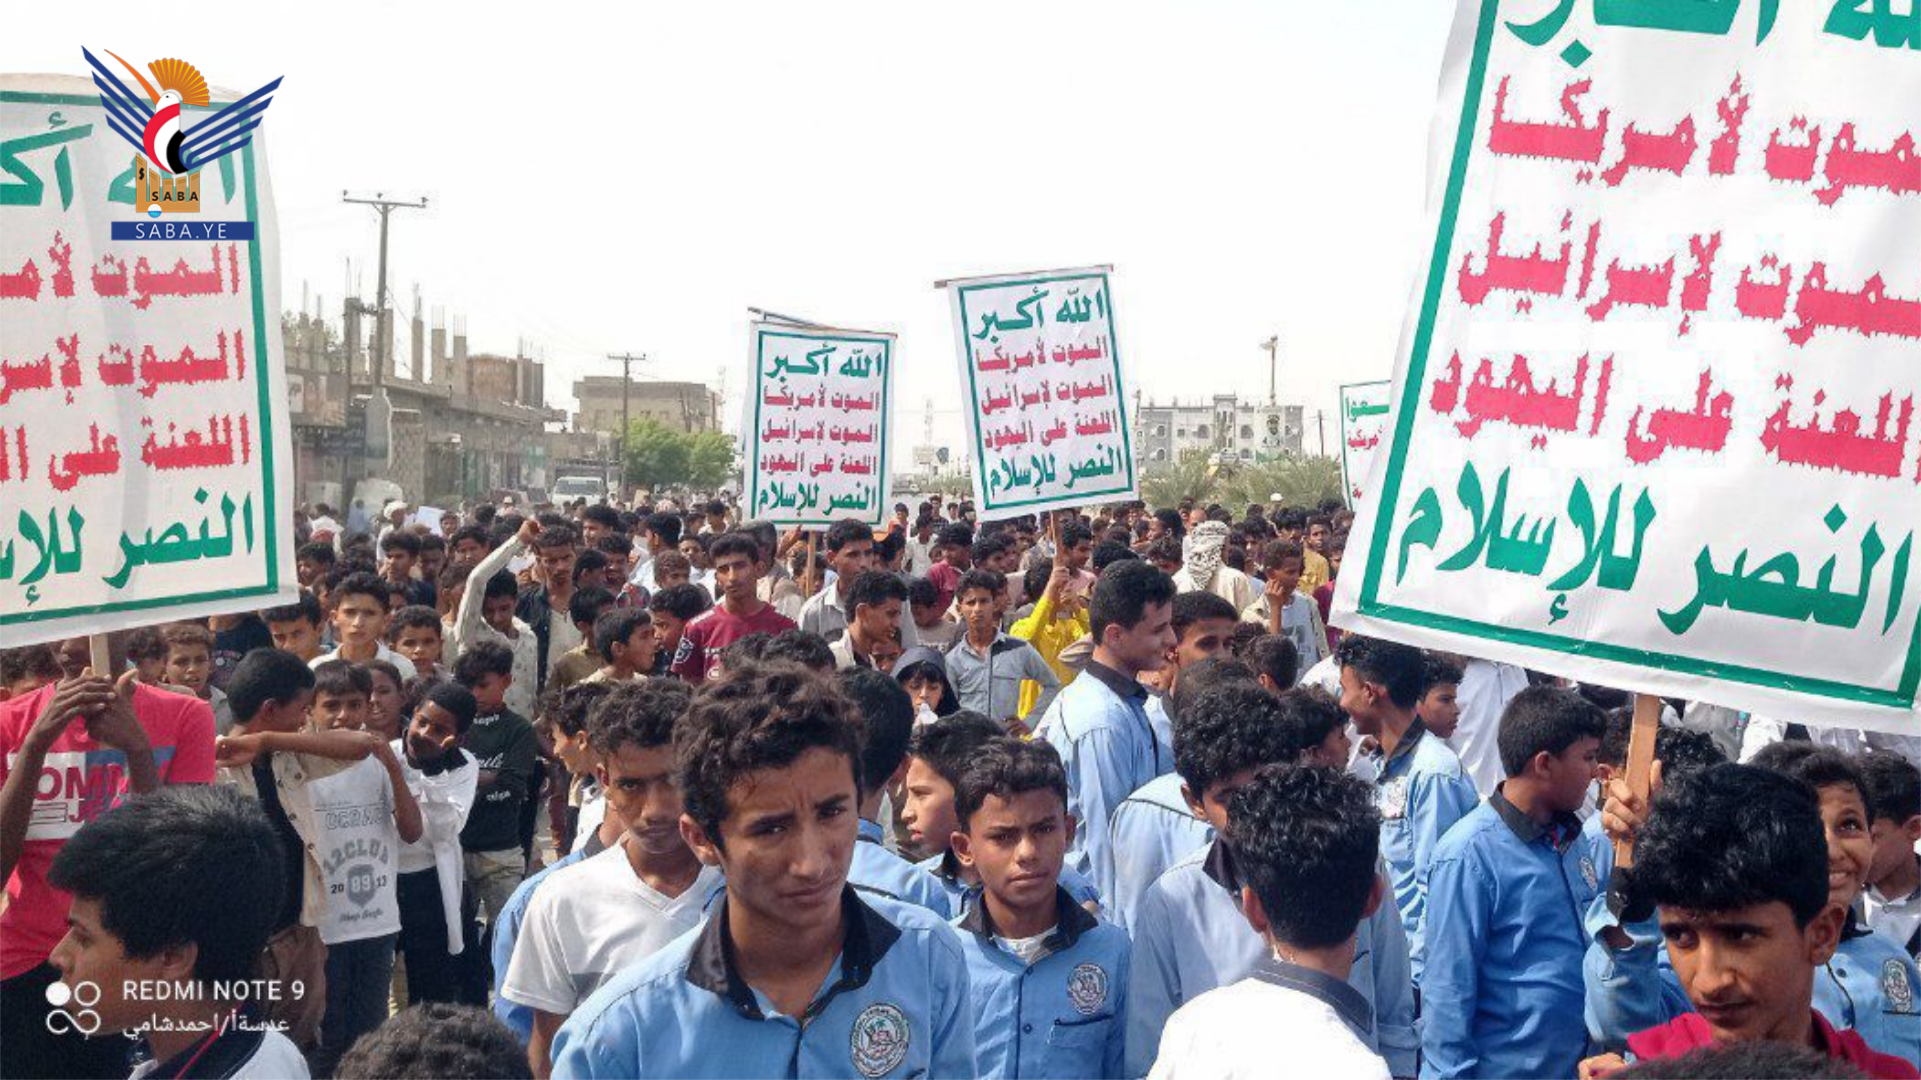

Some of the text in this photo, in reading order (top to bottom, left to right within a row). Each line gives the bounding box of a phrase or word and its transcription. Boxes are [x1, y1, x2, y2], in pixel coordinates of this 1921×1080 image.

[1488, 74, 1749, 186] لأمريكا
[91, 245, 239, 310] الموت
[1458, 212, 1721, 334] لإسرائيل
[971, 286, 1050, 344] أكبر
[98, 330, 246, 398] الموت
[764, 343, 837, 383] أكبر
[976, 335, 1109, 375] الموت لأمريكا
[763, 382, 880, 414] الموت لأمريكا
[1056, 373, 1114, 405] الموت
[1430, 353, 1612, 448] اليهود
[1626, 370, 1733, 464] على
[48, 424, 121, 492] على
[142, 414, 250, 470] اللعنة
[829, 423, 878, 446] الموت
[984, 408, 1119, 452] اللعنة على اليهود
[760, 451, 877, 478] اللعنة على اليهود
[990, 442, 1123, 500] النصر للإسلام
[758, 480, 877, 518] النصر للإسلام
[0, 489, 254, 608] النصر للإس
[1395, 458, 1912, 635] النصر للإسلام
